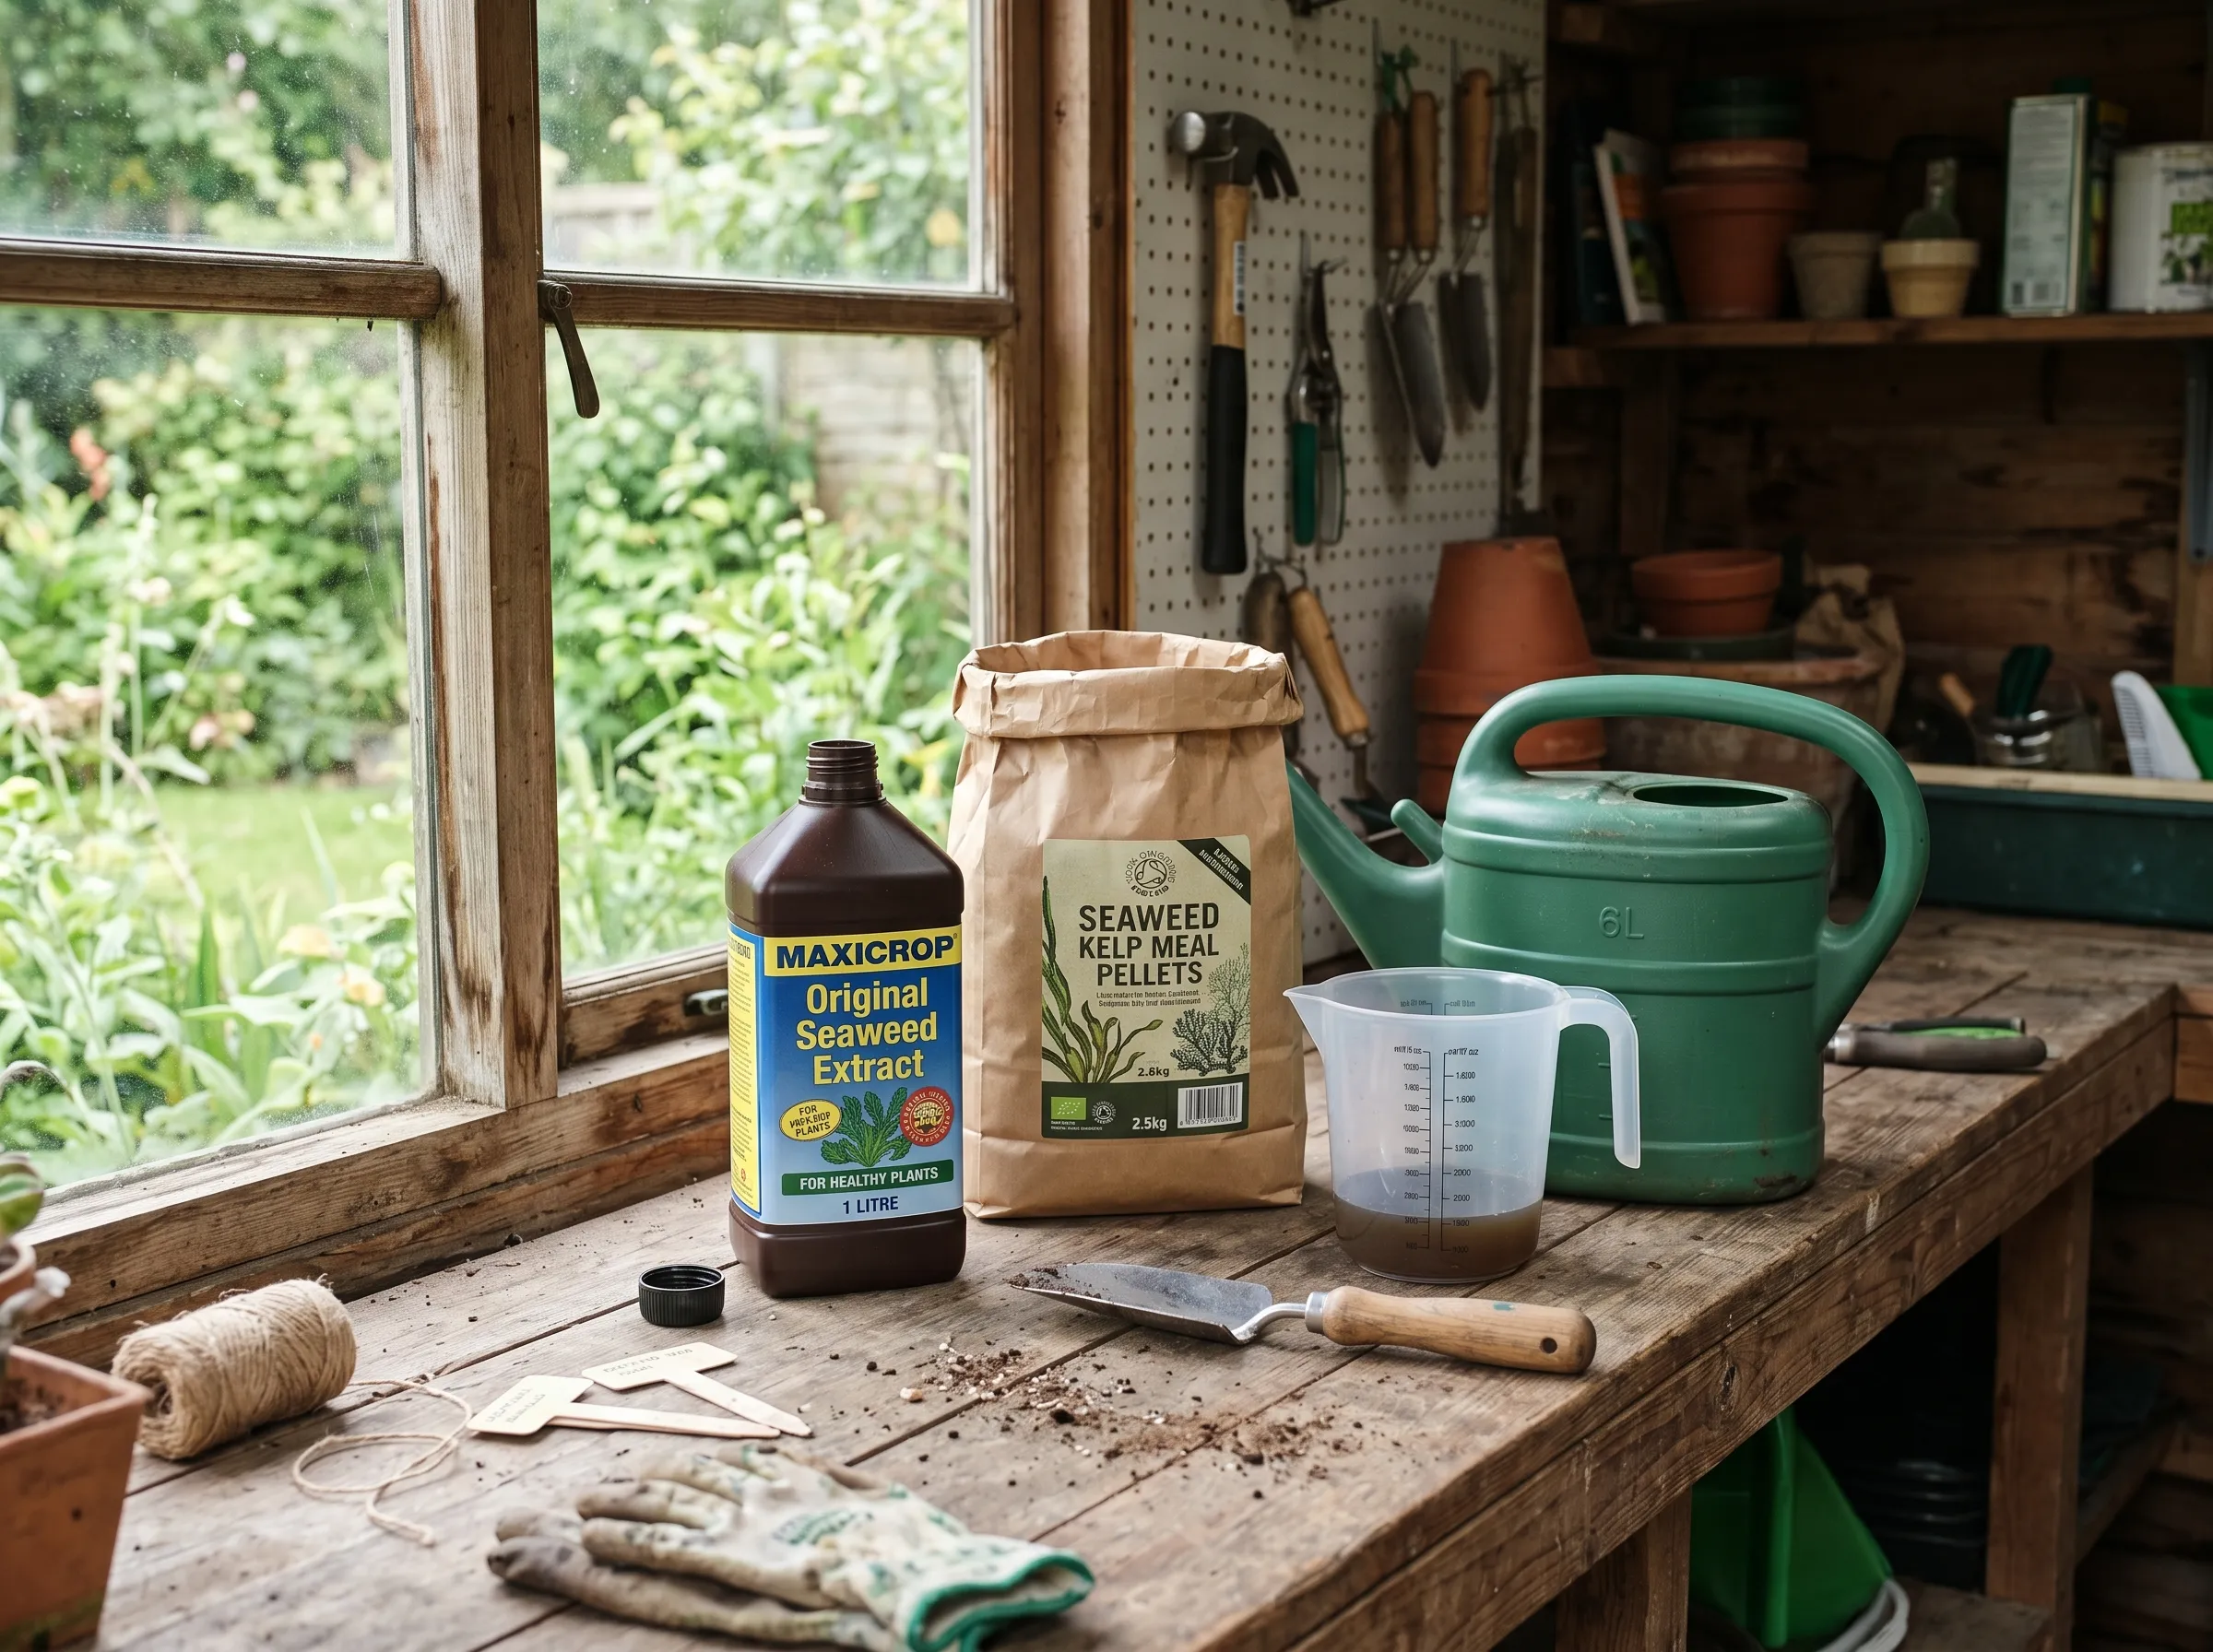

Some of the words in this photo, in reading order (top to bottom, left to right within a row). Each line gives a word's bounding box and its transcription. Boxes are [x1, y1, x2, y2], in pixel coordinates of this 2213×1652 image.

[1079, 902, 1219, 932] SEAWEED
[1599, 906, 1644, 939] 6L
[1080, 936, 1142, 960] KELP
[1152, 933, 1219, 959] MEAL
[1097, 961, 1202, 986] PELLETS
[807, 977, 929, 1018] Original
[796, 1011, 937, 1051] Seaweed
[813, 1050, 924, 1086] Extract
[799, 1104, 818, 1116] FOR
[795, 1121, 831, 1138] PLANTS
[1132, 1117, 1167, 1132] 2.5kg
[800, 1175, 826, 1190] FOR
[830, 1171, 887, 1188] HEALTHY
[891, 1166, 939, 1185] PLANTS
[843, 1200, 850, 1215] 1
[857, 1196, 899, 1214] LITRE
